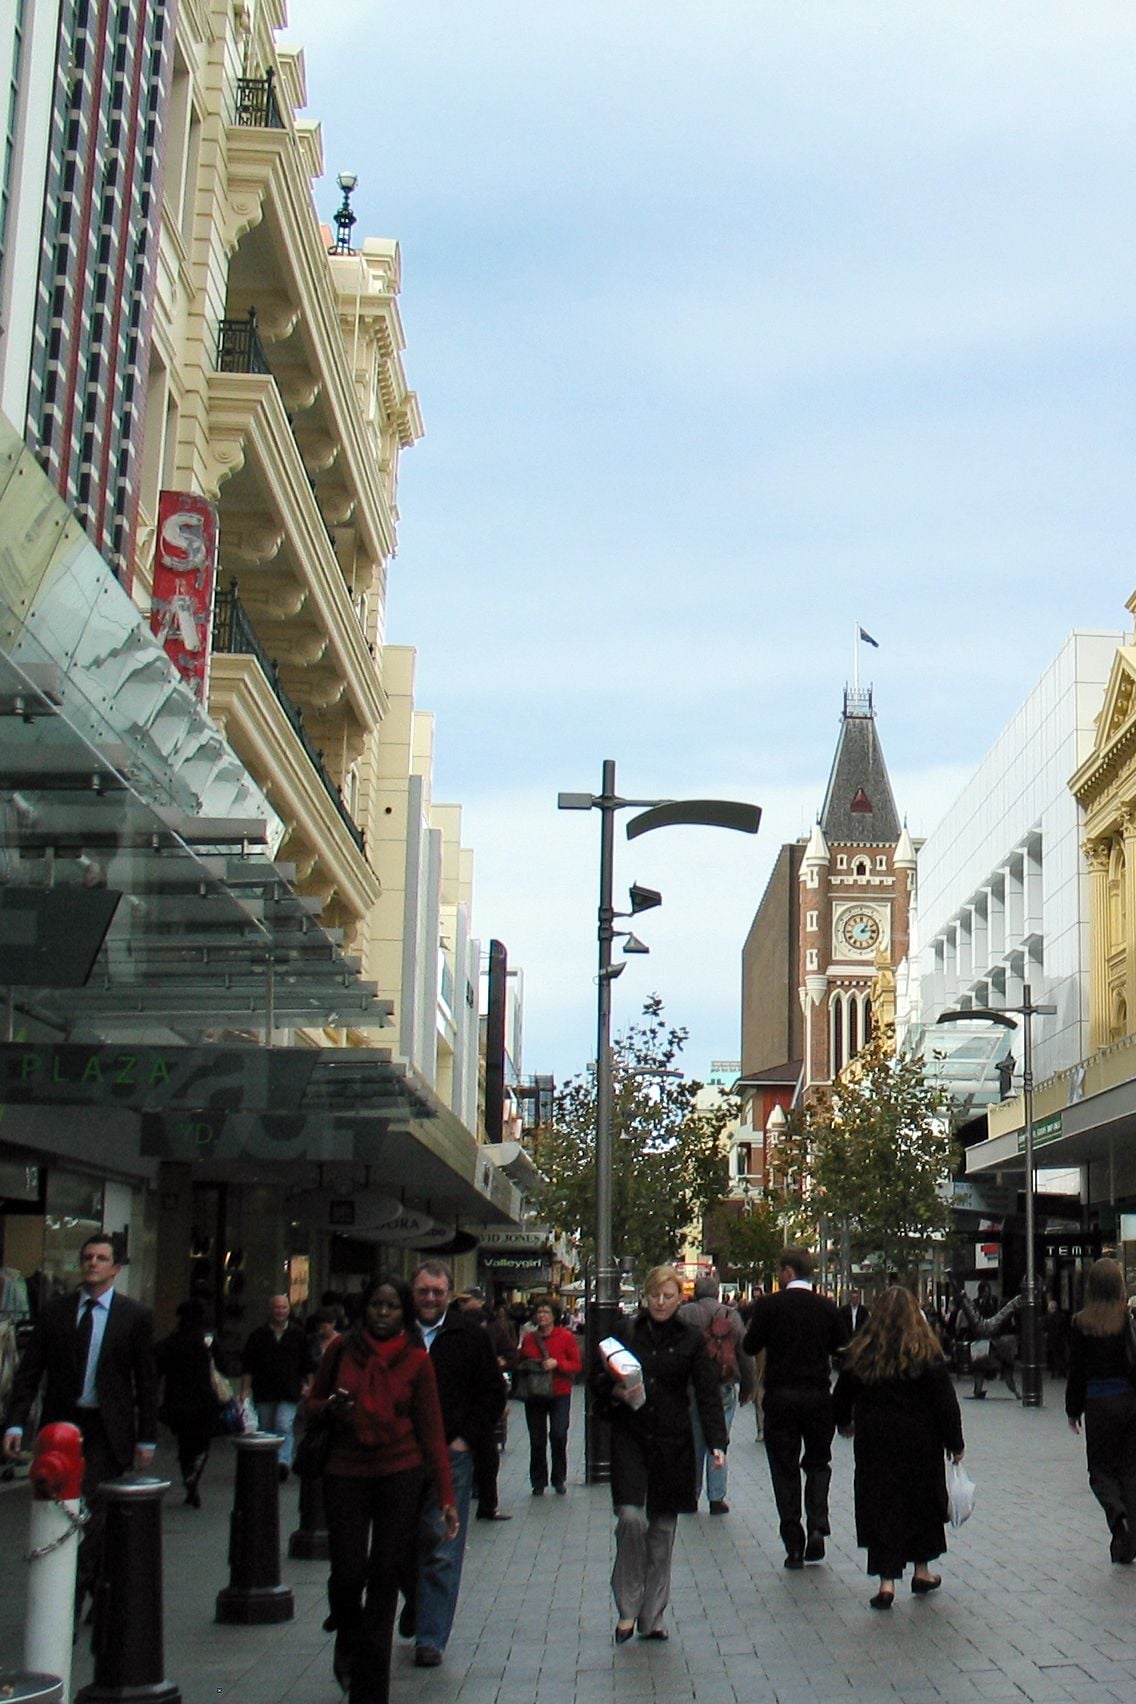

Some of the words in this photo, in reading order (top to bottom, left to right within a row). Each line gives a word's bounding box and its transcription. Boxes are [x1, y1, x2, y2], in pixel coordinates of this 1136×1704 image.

[20, 1053, 173, 1085] PLAZA
[479, 1234, 500, 1243] VID
[503, 1234, 541, 1243] JONES
[483, 1258, 542, 1270] Valleygirl
